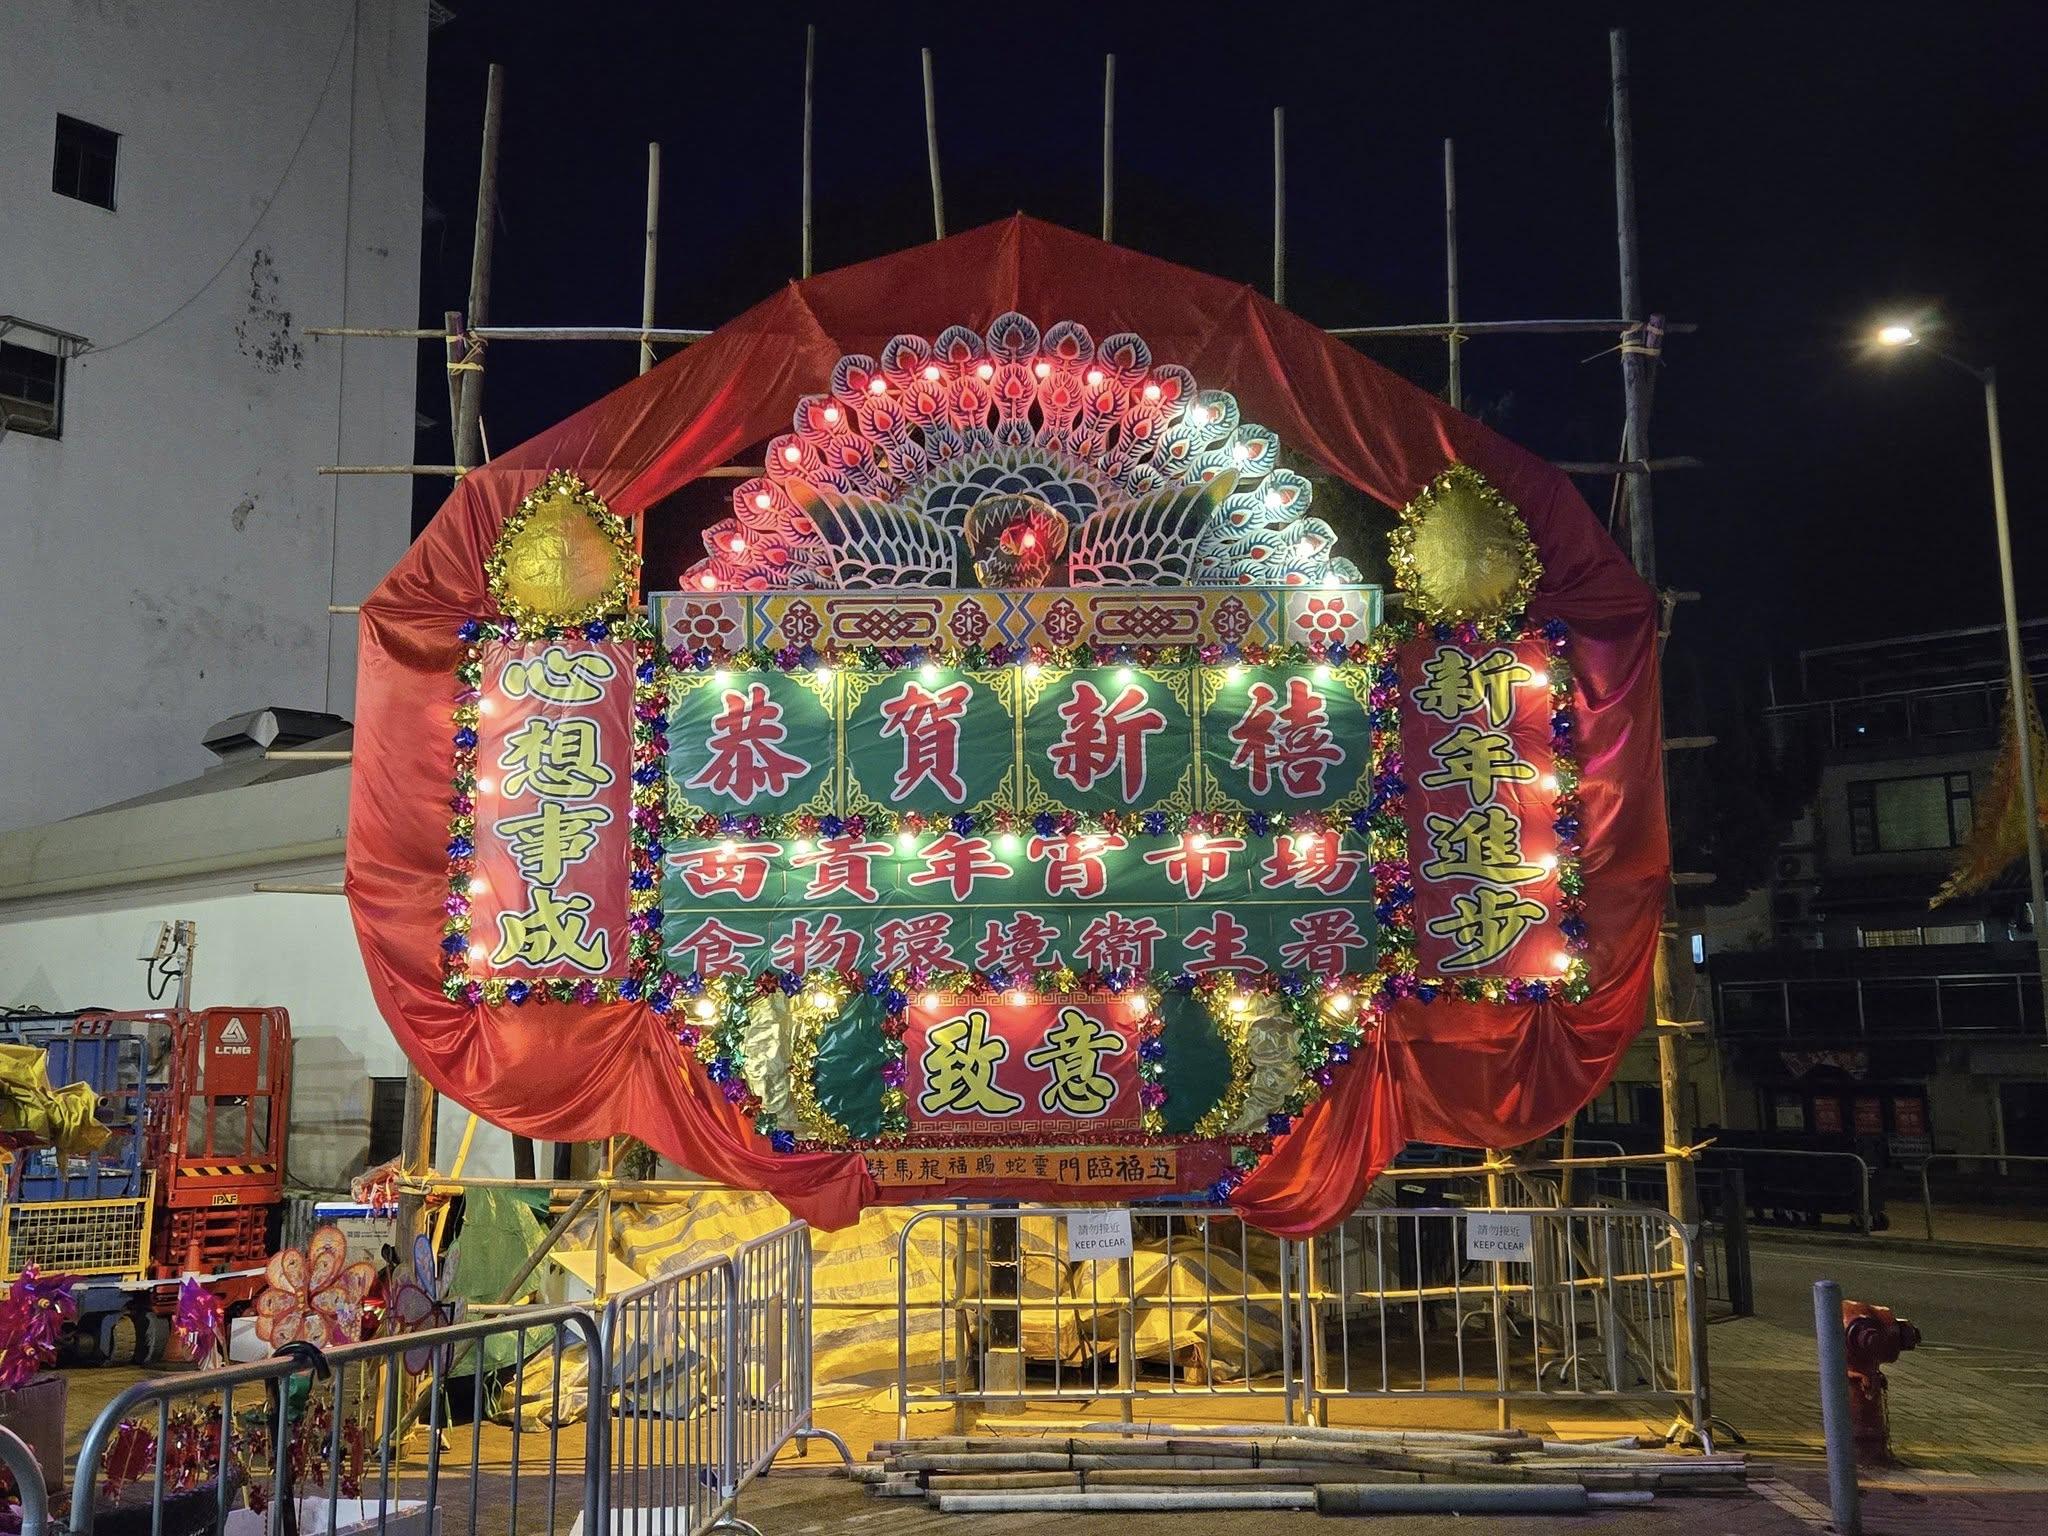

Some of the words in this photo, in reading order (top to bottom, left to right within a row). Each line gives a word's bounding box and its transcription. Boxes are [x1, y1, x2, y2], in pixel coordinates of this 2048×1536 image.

[685, 680, 1346, 806] 恭賀新禧
[491, 648, 616, 974] 心想事成
[1411, 646, 1549, 972] 新年進步
[665, 830, 1367, 902] 西貢年宵市場
[916, 1006, 1127, 1117] 致意
[213, 1193, 237, 1205] IPAF
[1075, 1240, 1097, 1250] KEEP
[1098, 1238, 1126, 1249] CLEAR
[1473, 1241, 1496, 1250] KEEP
[1497, 1241, 1525, 1251] CLEAR
